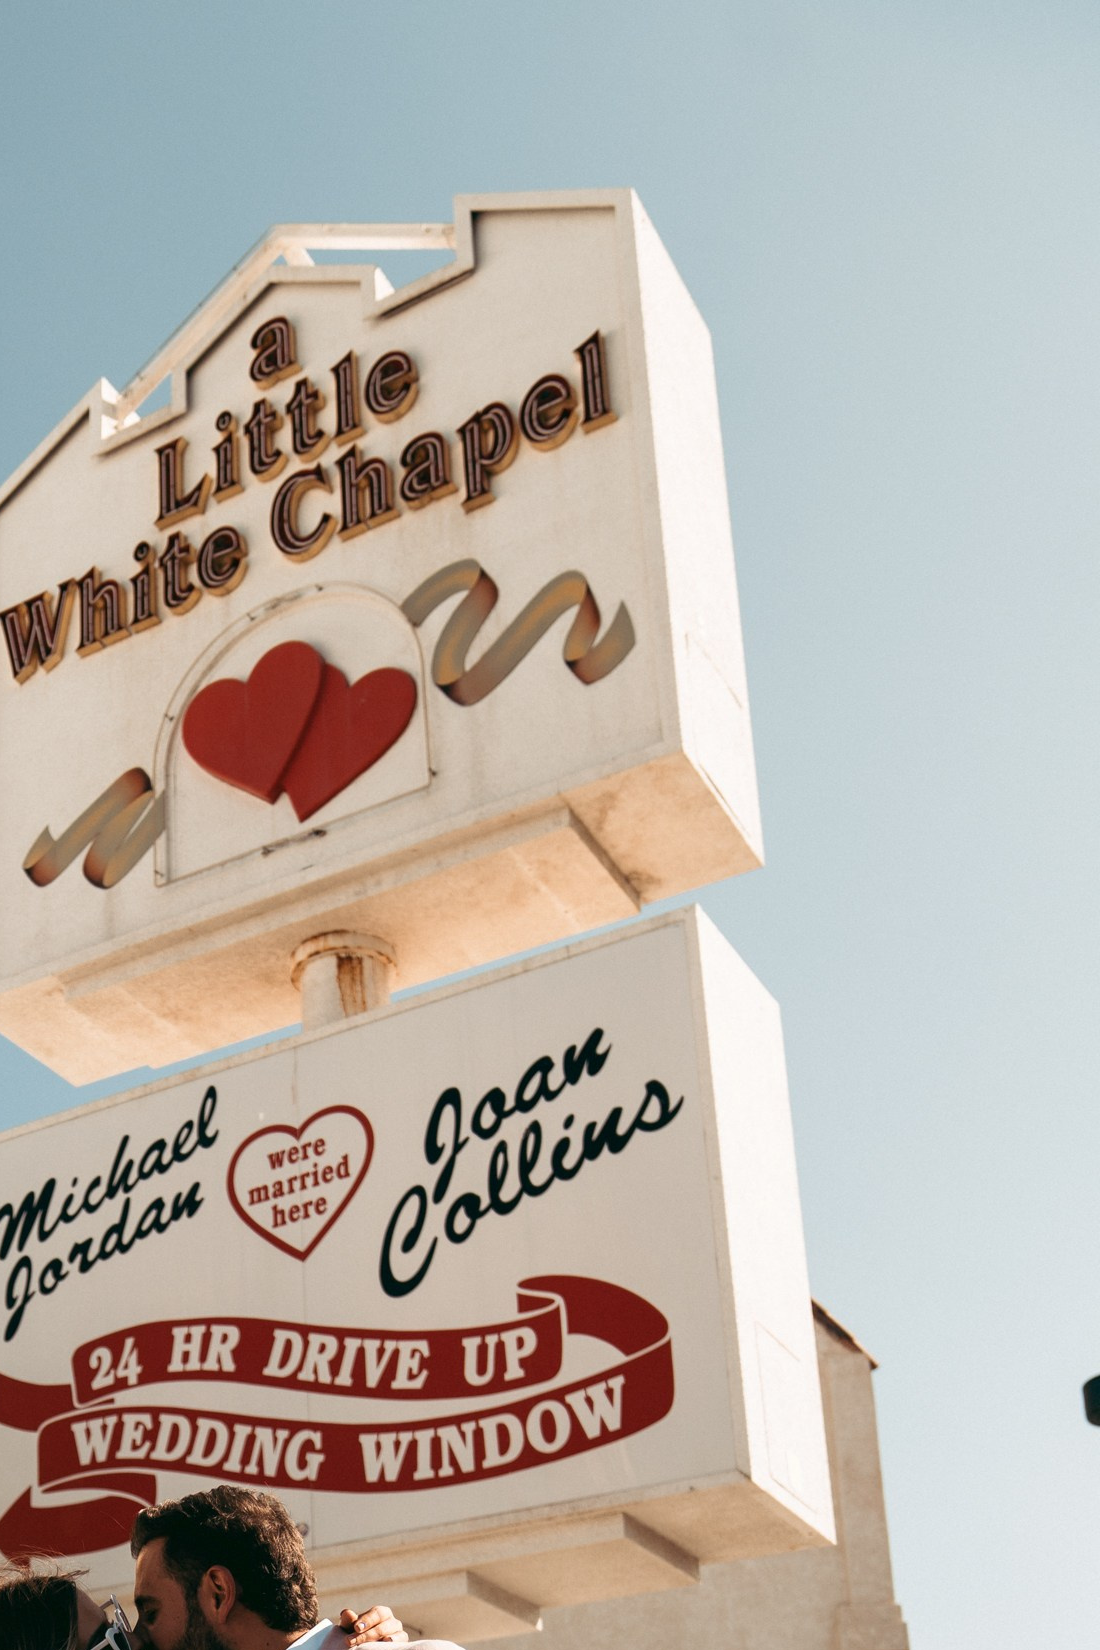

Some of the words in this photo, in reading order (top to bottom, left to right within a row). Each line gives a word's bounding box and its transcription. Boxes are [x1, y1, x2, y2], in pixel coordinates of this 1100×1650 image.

[248, 315, 298, 390] a
[154, 348, 420, 531] Little
[269, 329, 619, 563] Chapel
[267, 1136, 327, 1171] were
[423, 1027, 613, 1185] Joan
[247, 1155, 351, 1205] married
[270, 1193, 328, 1230] here
[378, 1078, 685, 1299] Collins
[4, 1181, 204, 1342] Jordan
[88, 1344, 143, 1391] 24
[166, 1326, 238, 1374] HR
[263, 1328, 430, 1391] DRIVE
[461, 1328, 539, 1387] UP
[71, 1413, 326, 1482] WEDDING
[359, 1375, 626, 1484] WINDOW
